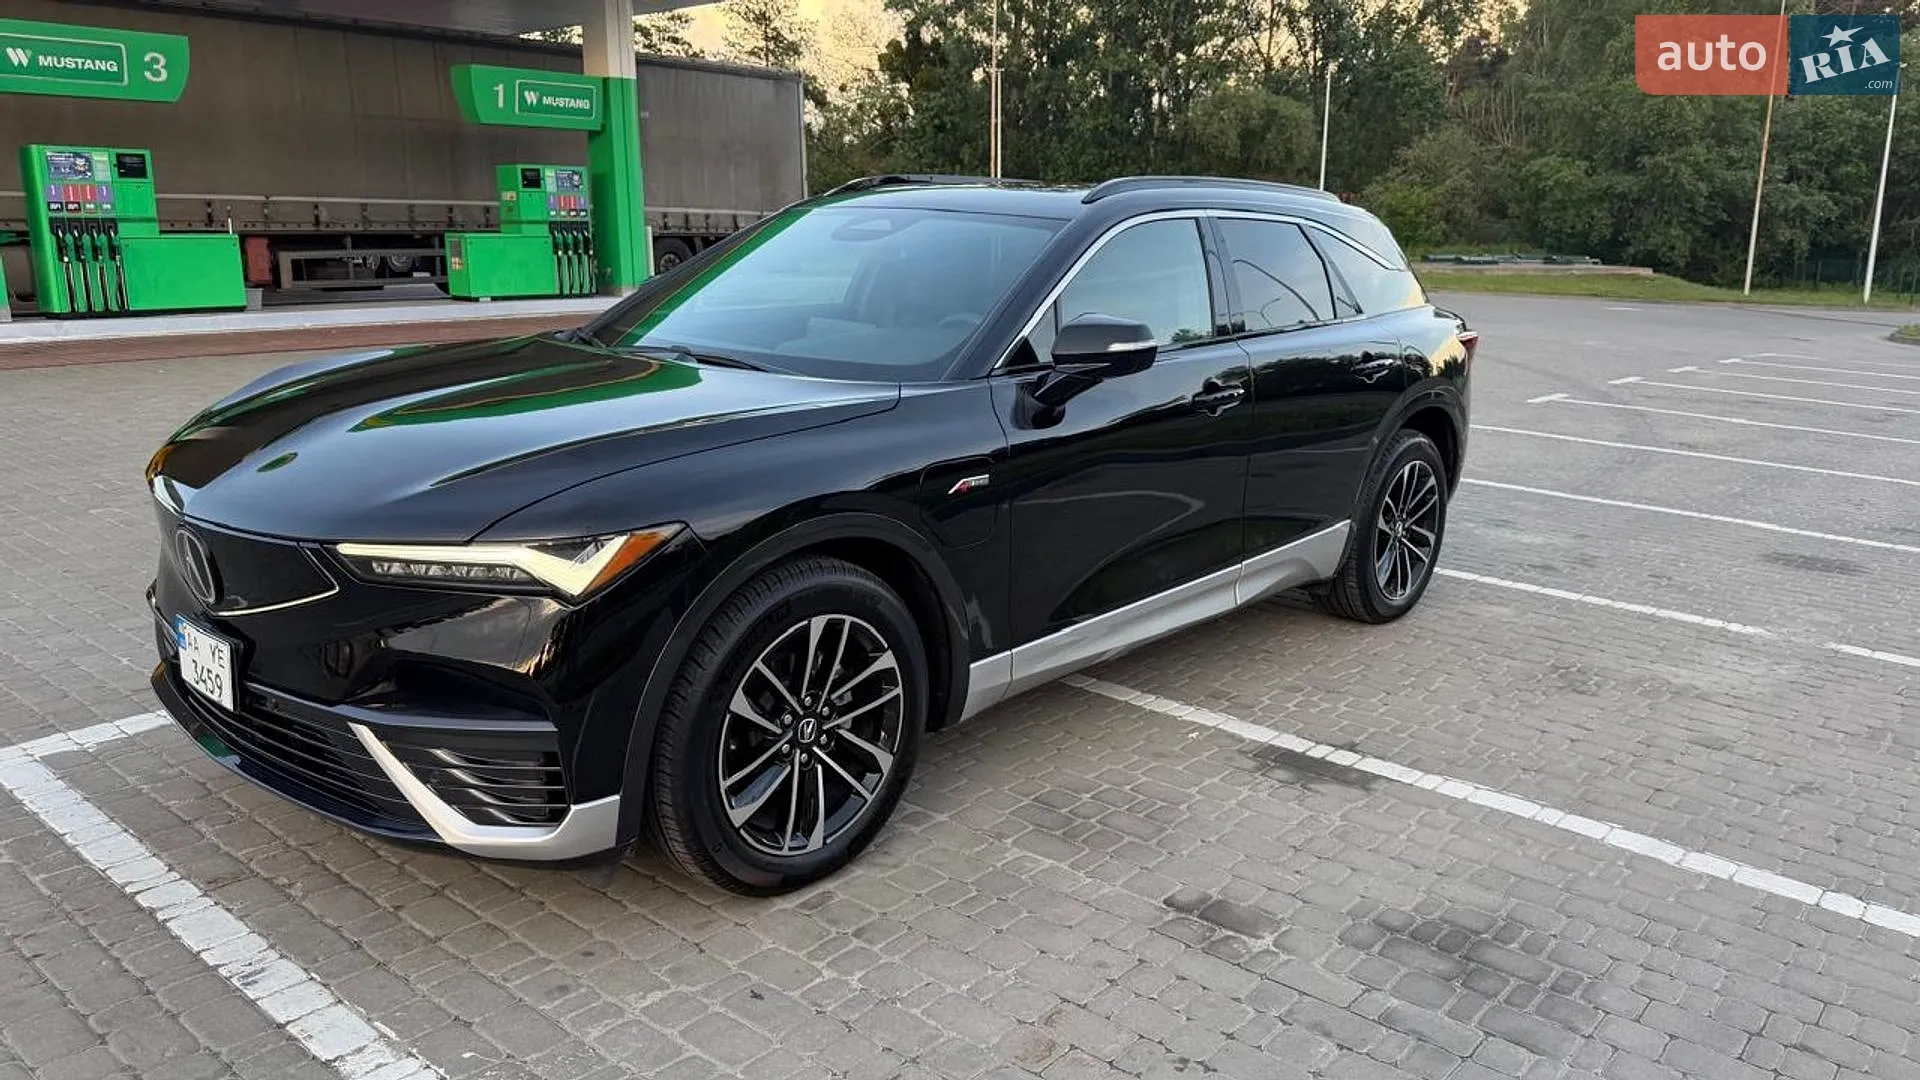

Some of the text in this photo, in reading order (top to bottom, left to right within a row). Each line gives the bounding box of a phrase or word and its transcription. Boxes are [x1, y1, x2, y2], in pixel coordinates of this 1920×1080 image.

[38, 55, 118, 72] MUSTANG
[143, 52, 168, 82] 3
[493, 83, 505, 109] 1
[542, 95, 591, 110] MUSTANG
[191, 657, 224, 699] 3459
